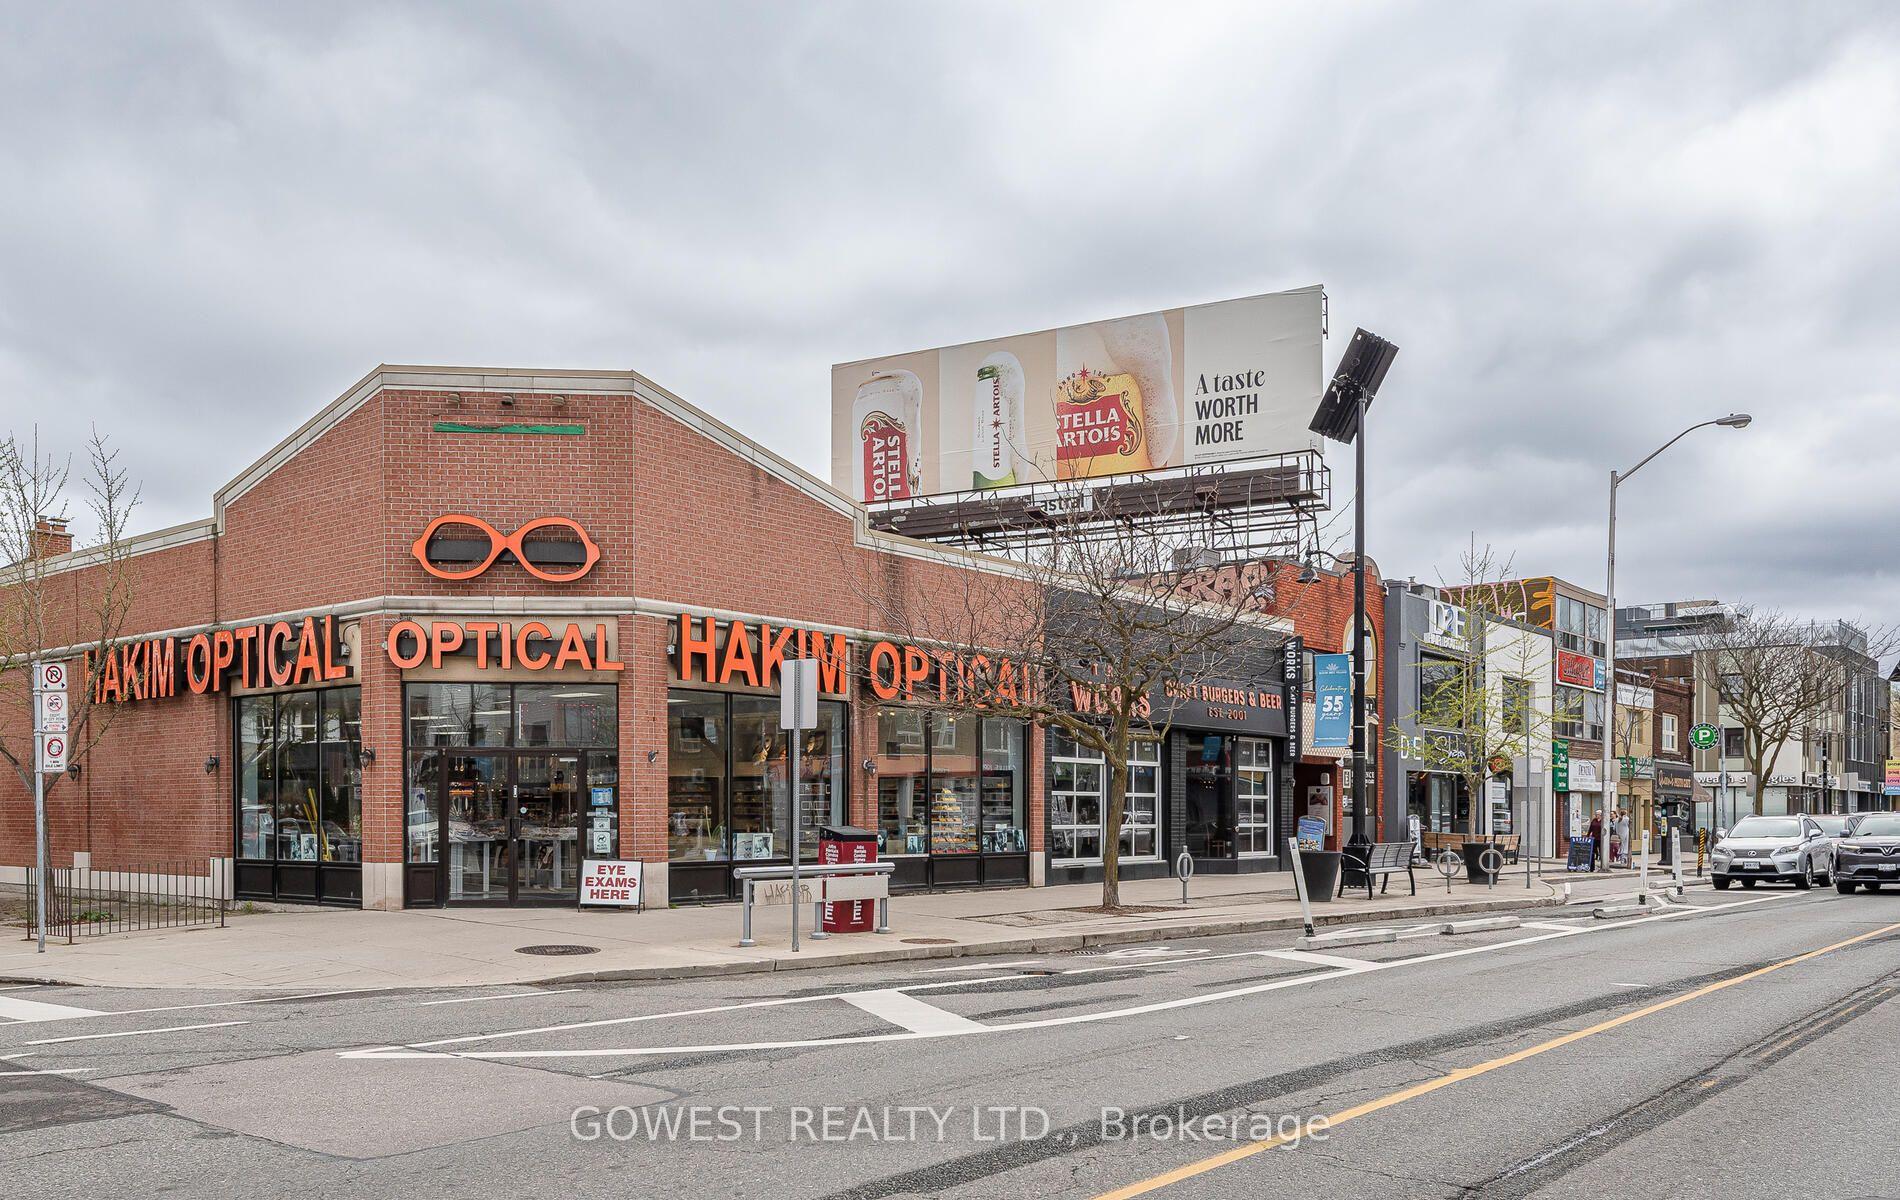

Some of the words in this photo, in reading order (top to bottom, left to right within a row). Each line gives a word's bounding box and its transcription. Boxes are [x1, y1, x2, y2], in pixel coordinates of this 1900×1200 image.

[1195, 373, 1209, 396] A
[1214, 368, 1266, 393] taste
[992, 377, 1001, 417] ARTOIS
[1195, 393, 1258, 421] WORTH
[1195, 420, 1244, 446] MORE
[992, 431, 1001, 468] STELLA
[84, 637, 175, 704] HAKIM
[187, 614, 347, 694] OPTICAL
[387, 621, 625, 671] OPTICAL
[1286, 641, 1297, 679] WORKS
[1201, 685, 1246, 706] BURGERS
[1247, 691, 1257, 708] &
[1258, 692, 1283, 711] BEER
[1322, 695, 1344, 713] 55
[1227, 708, 1247, 721] 2001
[1698, 729, 1711, 741] P
[1698, 774, 1734, 784] weah
[585, 876, 637, 888] EXAMS
[597, 865, 626, 876] EYE
[589, 889, 630, 900] HERE
